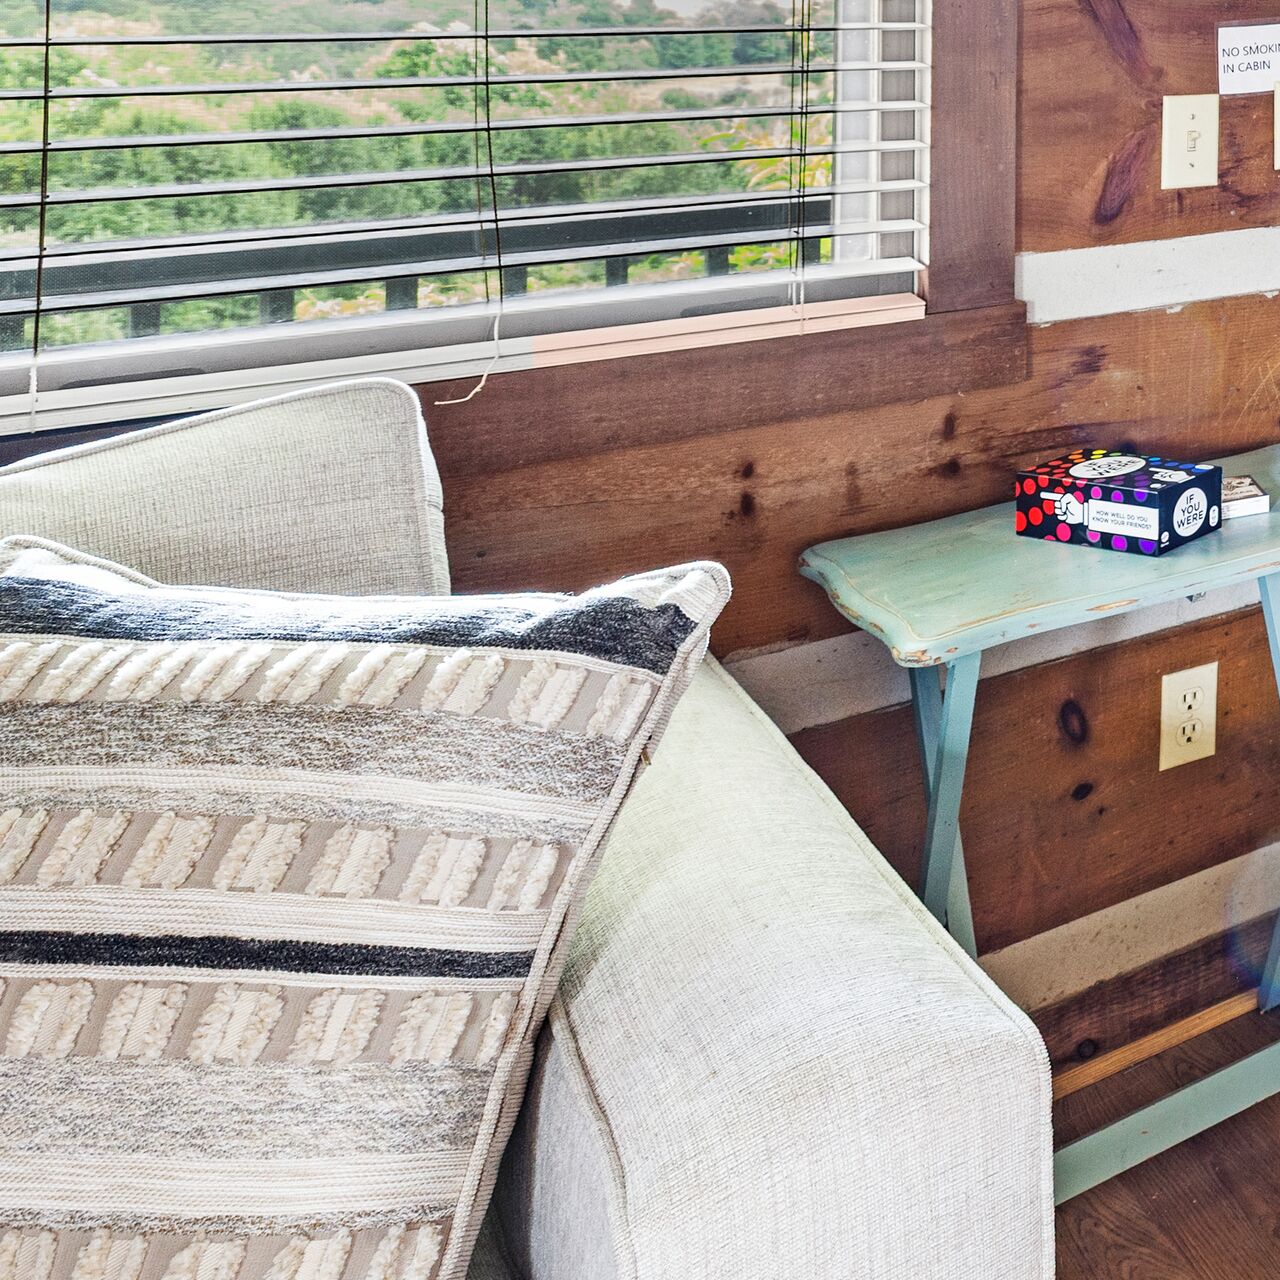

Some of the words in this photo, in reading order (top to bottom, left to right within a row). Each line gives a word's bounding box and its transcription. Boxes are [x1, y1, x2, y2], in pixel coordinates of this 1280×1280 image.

[1222, 46, 1240, 58] NO
[1222, 63, 1235, 74] IN
[1237, 59, 1271, 73] CABIN
[1087, 459, 1122, 472] YOU
[1091, 459, 1141, 476] WERE
[1186, 493, 1195, 505] IF
[1111, 511, 1125, 519] WELL
[1180, 501, 1201, 517] YOU
[1092, 516, 1109, 524] KNOW
[1126, 522, 1152, 530] FRIENDS?
[1176, 509, 1204, 529] WERE
